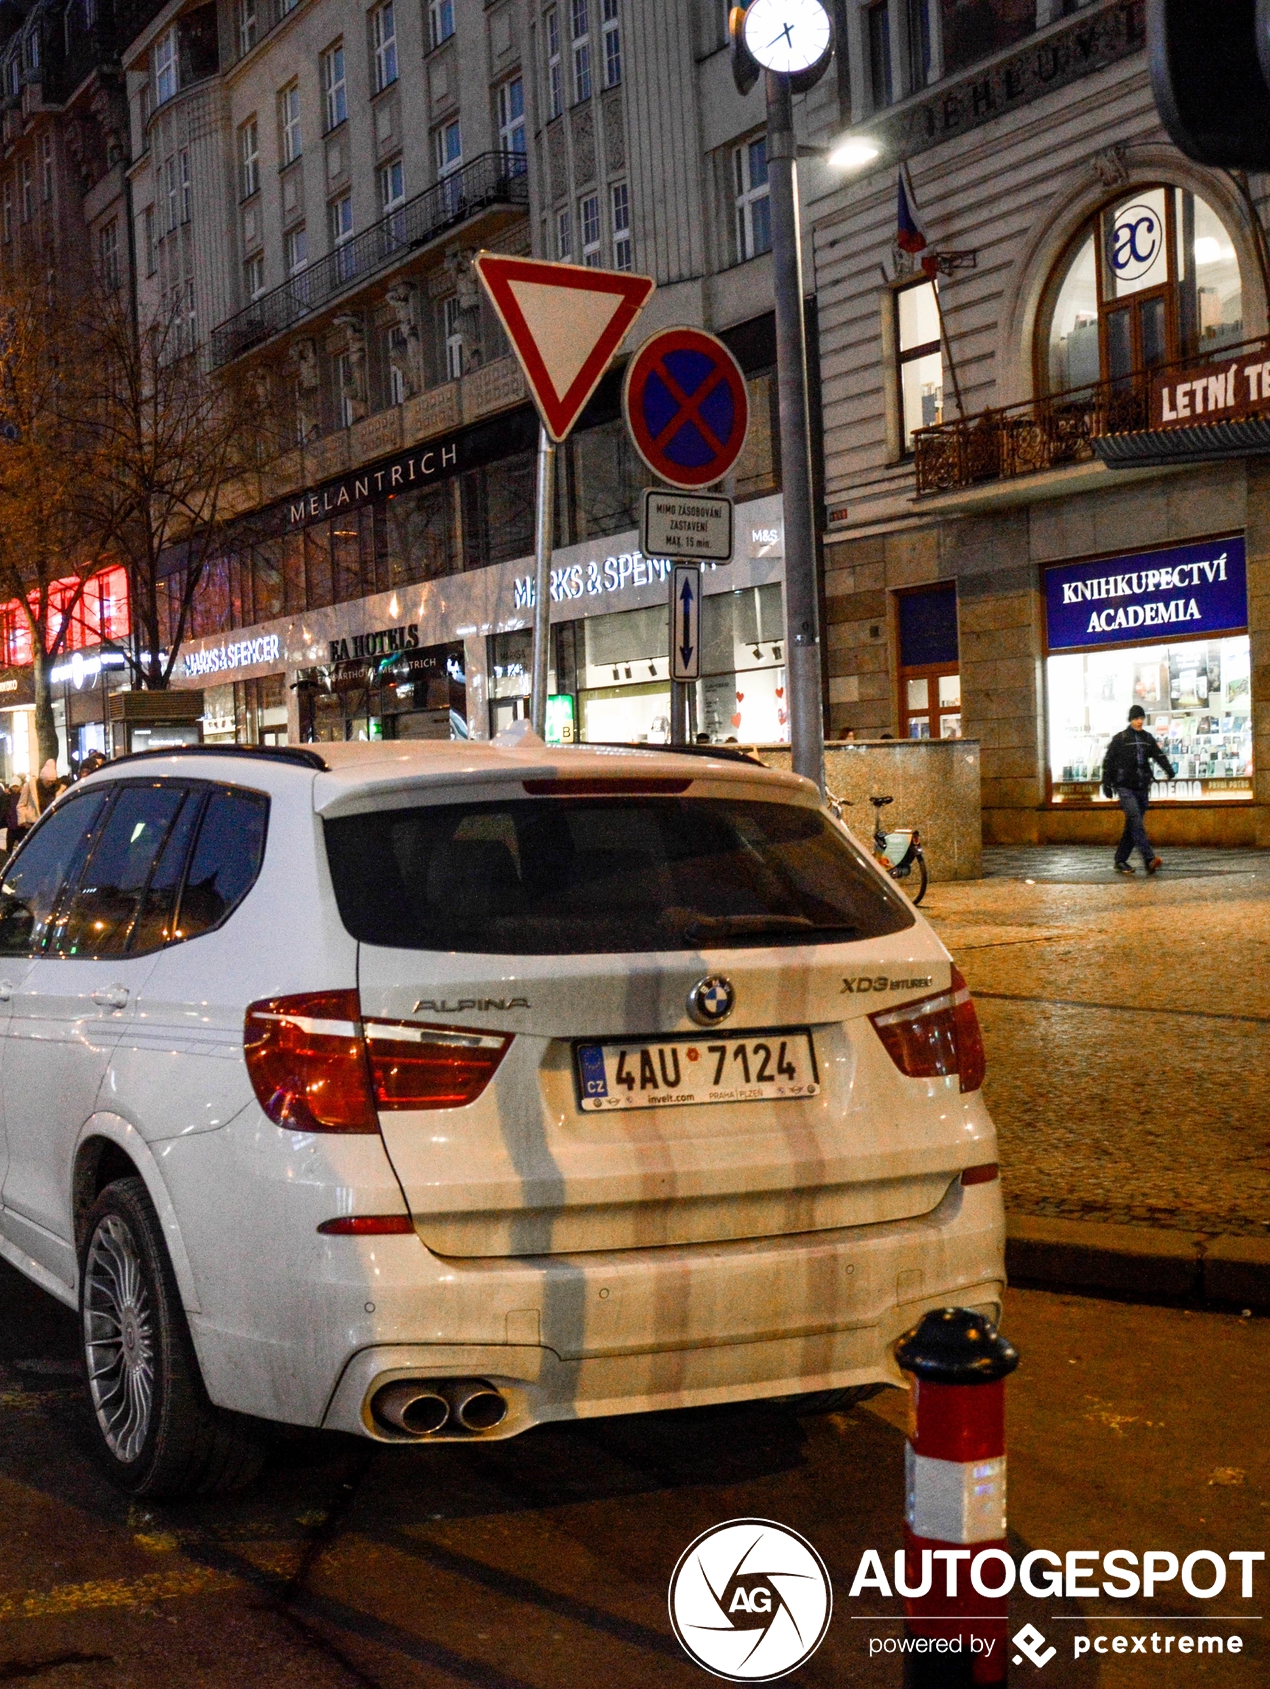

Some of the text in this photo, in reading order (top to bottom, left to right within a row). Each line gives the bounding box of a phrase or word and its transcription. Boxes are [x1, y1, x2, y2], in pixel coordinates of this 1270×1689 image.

[1162, 363, 1238, 422] LETNÍ
[289, 443, 458, 524] MELANTRICH
[656, 503, 676, 515] MIMO
[670, 519, 708, 533] ZASTAVENÍ
[752, 528, 778, 543] M&S
[685, 536, 694, 548] 15
[586, 561, 602, 596] &
[1062, 552, 1228, 604] KNIHKUPECTVÍ
[1086, 597, 1202, 633] ACADEMIA
[185, 647, 220, 677] MARKS
[228, 634, 280, 669] SPENCER
[329, 623, 420, 662] EA HOTELS
[840, 976, 889, 994] XD3
[412, 996, 531, 1014] ALPINA
[615, 1041, 796, 1092] 4AU 7124
[587, 1080, 606, 1094] CZ
[647, 1093, 695, 1104] invelt.com
